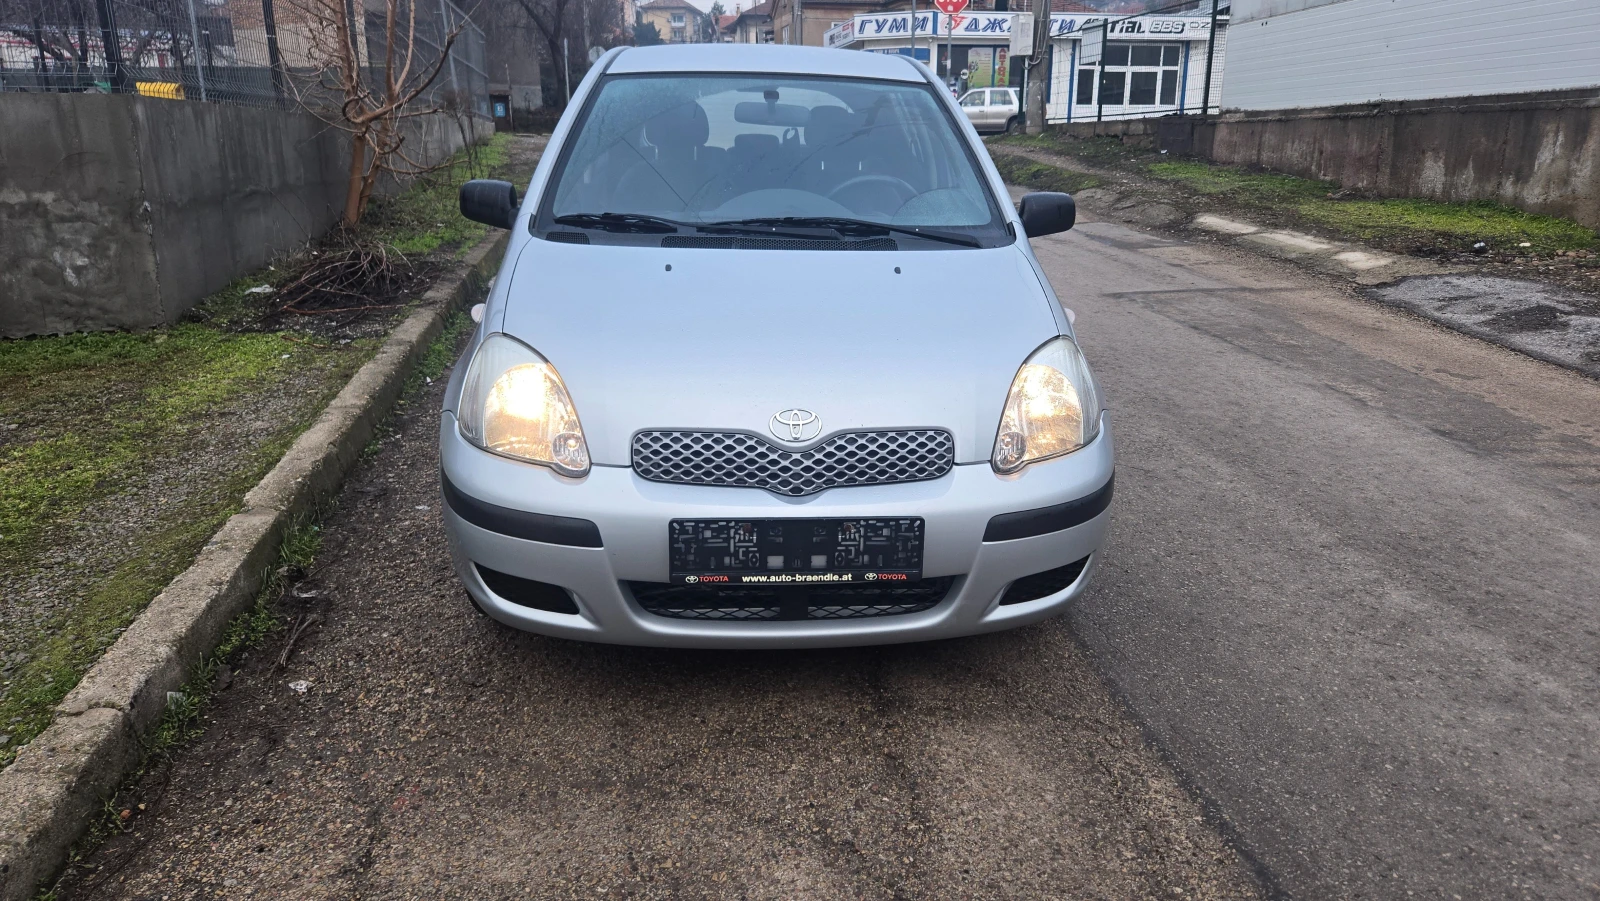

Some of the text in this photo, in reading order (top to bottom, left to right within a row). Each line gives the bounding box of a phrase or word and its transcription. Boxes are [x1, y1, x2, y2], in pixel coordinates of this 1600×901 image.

[858, 16, 930, 35] ГУМИ
[964, 17, 1076, 34] ДЖТИ
[1149, 20, 1186, 34] BBS
[699, 575, 729, 583] TOYOTA
[742, 573, 852, 583] www.auto-braendle.at
